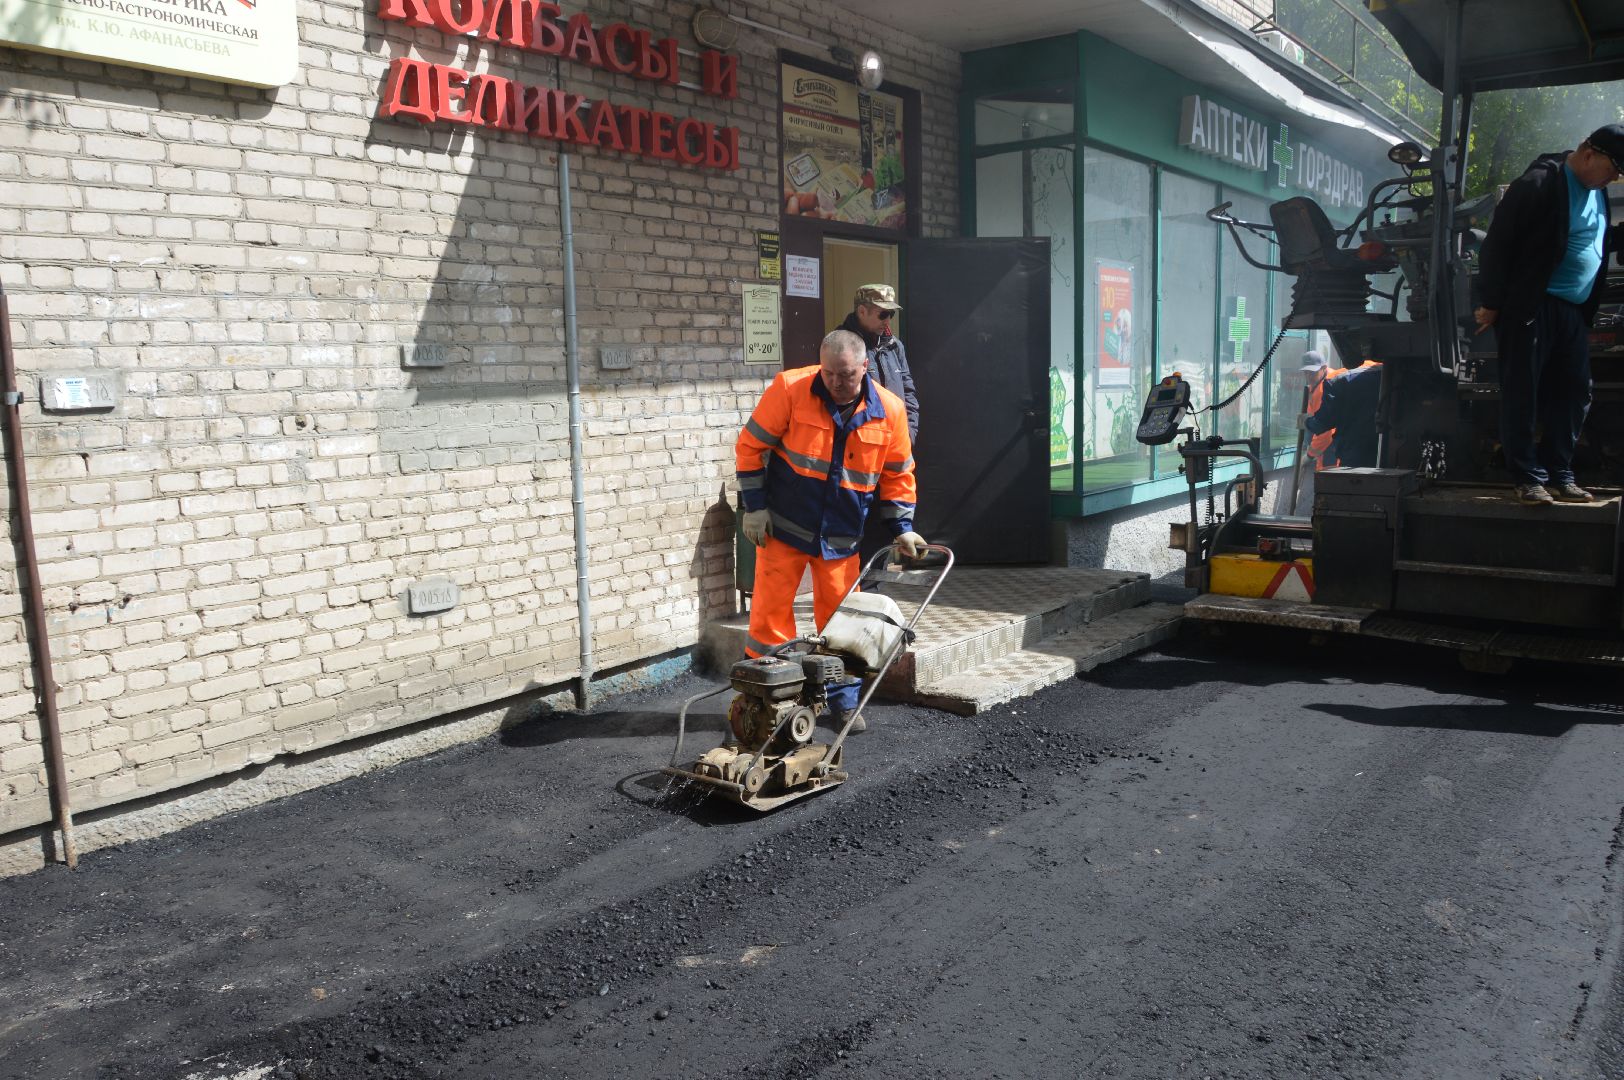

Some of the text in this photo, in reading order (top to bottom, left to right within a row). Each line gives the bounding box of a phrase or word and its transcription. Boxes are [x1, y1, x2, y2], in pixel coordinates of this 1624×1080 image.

[61, 0, 259, 39] НО-ГАСТРОНОМИЧЕСКАЯ
[88, 18, 124, 37] К.Ю.
[129, 27, 231, 56] АФАНАСЬЕВА
[703, 50, 738, 98] И
[381, 57, 740, 170] ДЕЛИКАТЕСЫ
[1191, 94, 1364, 208] АПТЕКИ ГОРЗДРАВ
